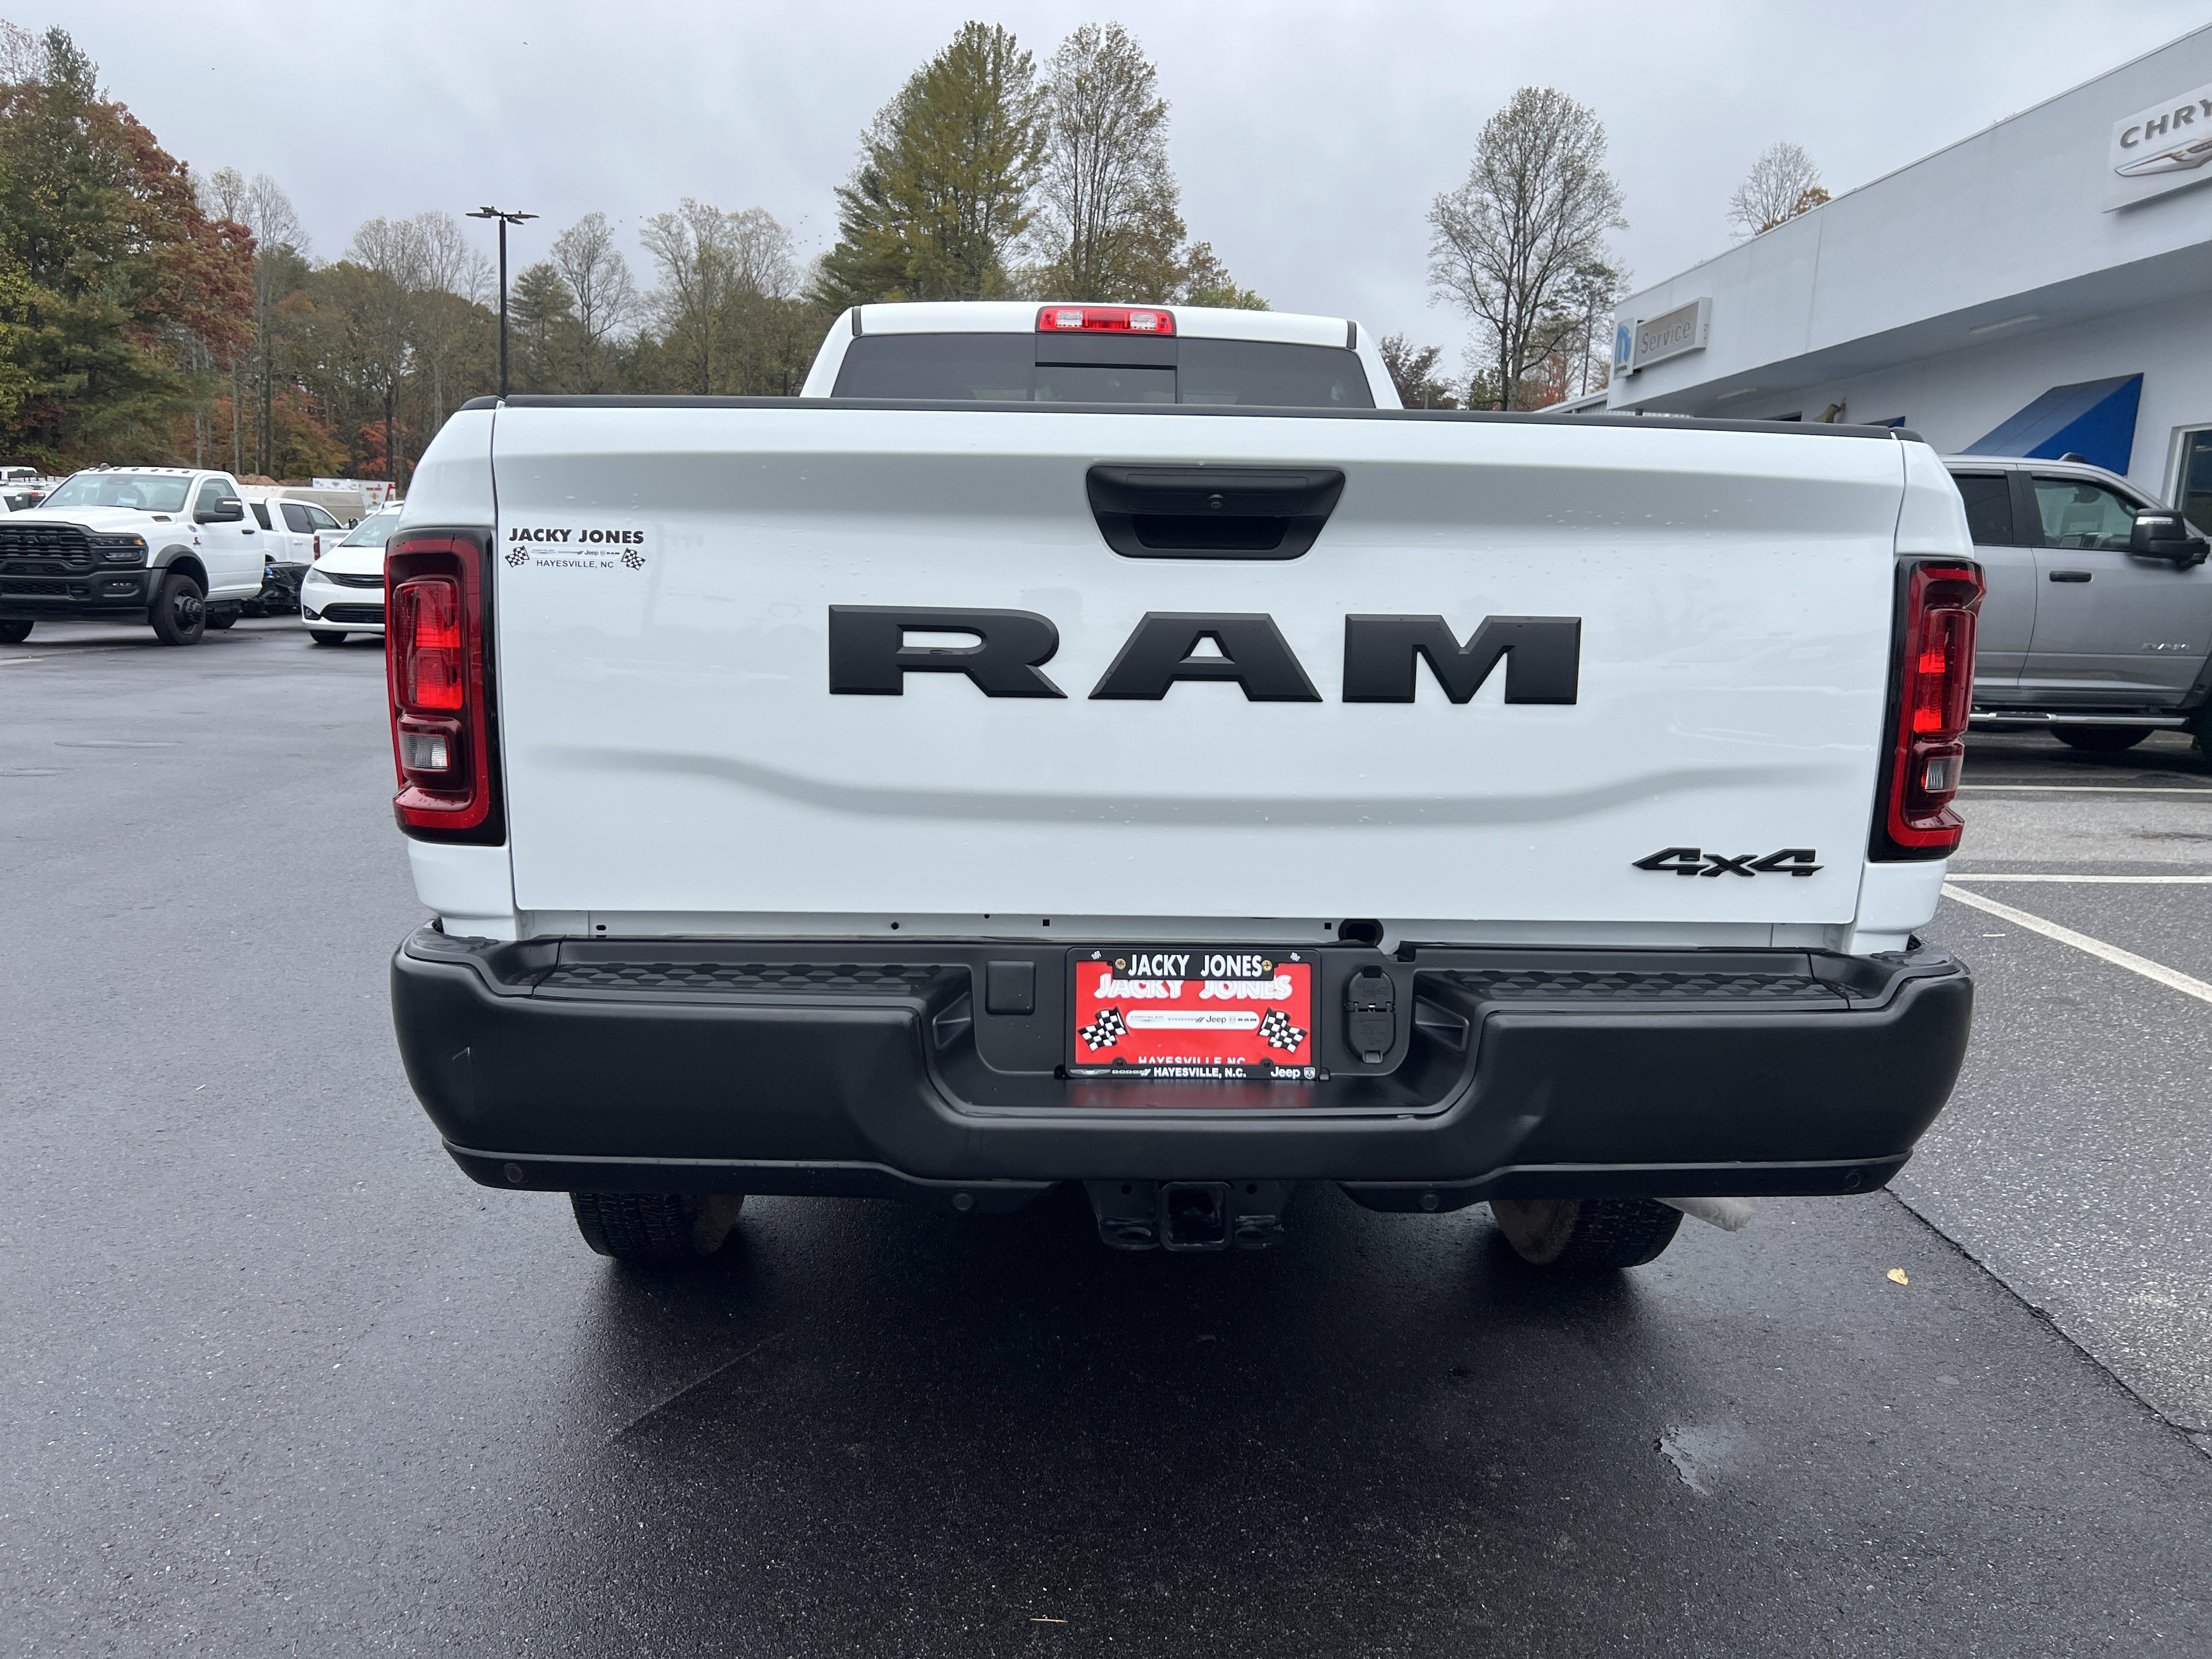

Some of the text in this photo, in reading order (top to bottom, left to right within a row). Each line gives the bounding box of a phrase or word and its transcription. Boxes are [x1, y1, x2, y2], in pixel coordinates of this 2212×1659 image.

[2120, 99, 2212, 149] CHRY
[1641, 321, 1690, 354] Service
[509, 528, 644, 544] JACKY JONES
[537, 560, 597, 568] HAYESVILLE,
[828, 604, 1582, 705] RAM
[1632, 847, 1825, 877] 4x4
[1128, 954, 1262, 977] JACKY JONES
[1093, 973, 1293, 1000] JACKY JONES
[1206, 1015, 1227, 1024] Jeep
[1154, 1067, 1222, 1078] HAYESVILLE,
[1224, 1067, 1247, 1077] N.C.
[1271, 1066, 1300, 1079] Jeep
